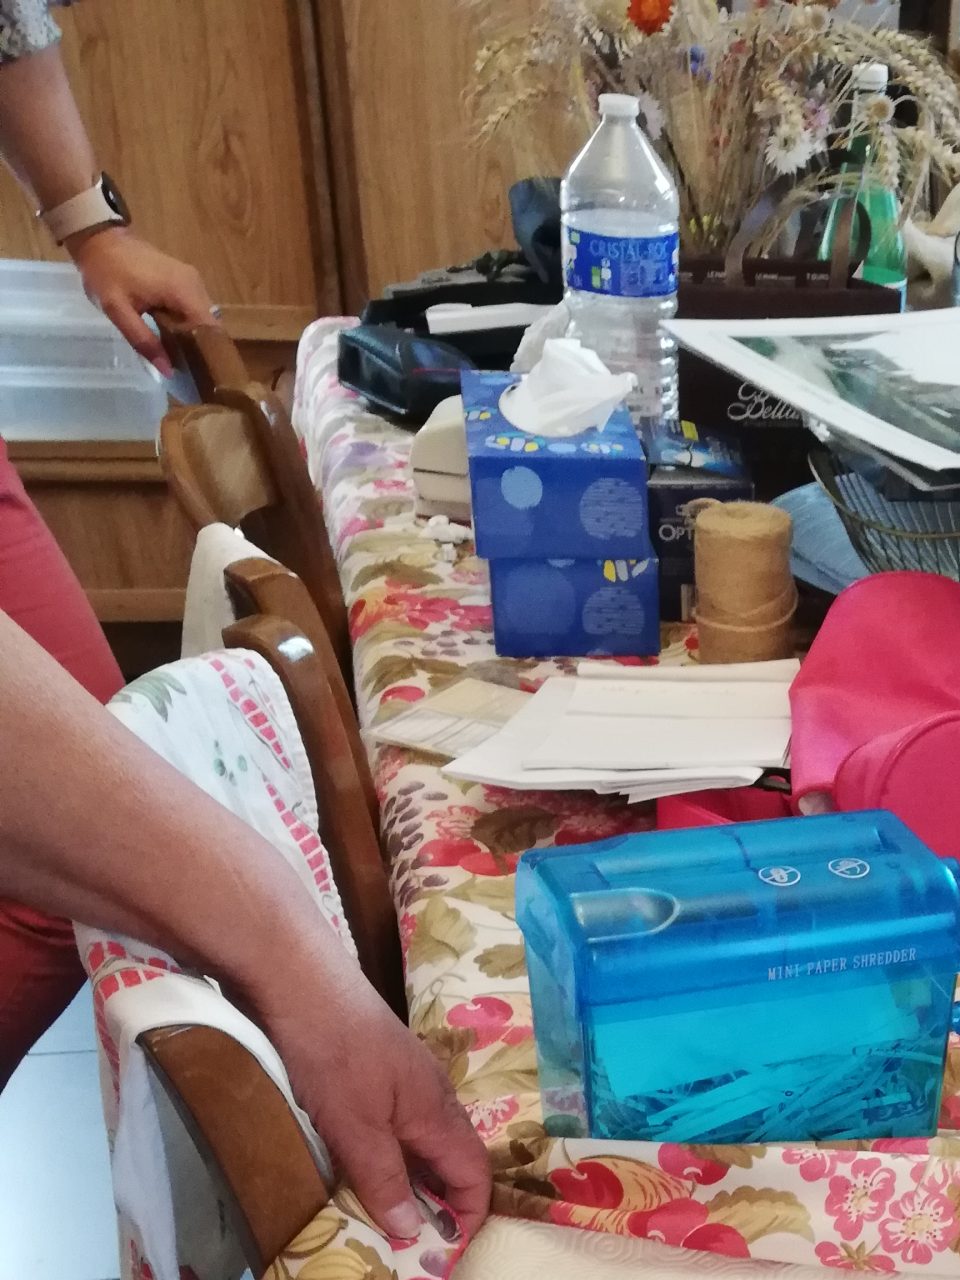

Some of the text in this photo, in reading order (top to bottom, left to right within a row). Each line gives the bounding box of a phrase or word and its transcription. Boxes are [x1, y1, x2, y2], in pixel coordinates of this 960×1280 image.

[658, 524, 692, 541] OPT
[767, 947, 917, 982] MINI PAPER SHREDDER
